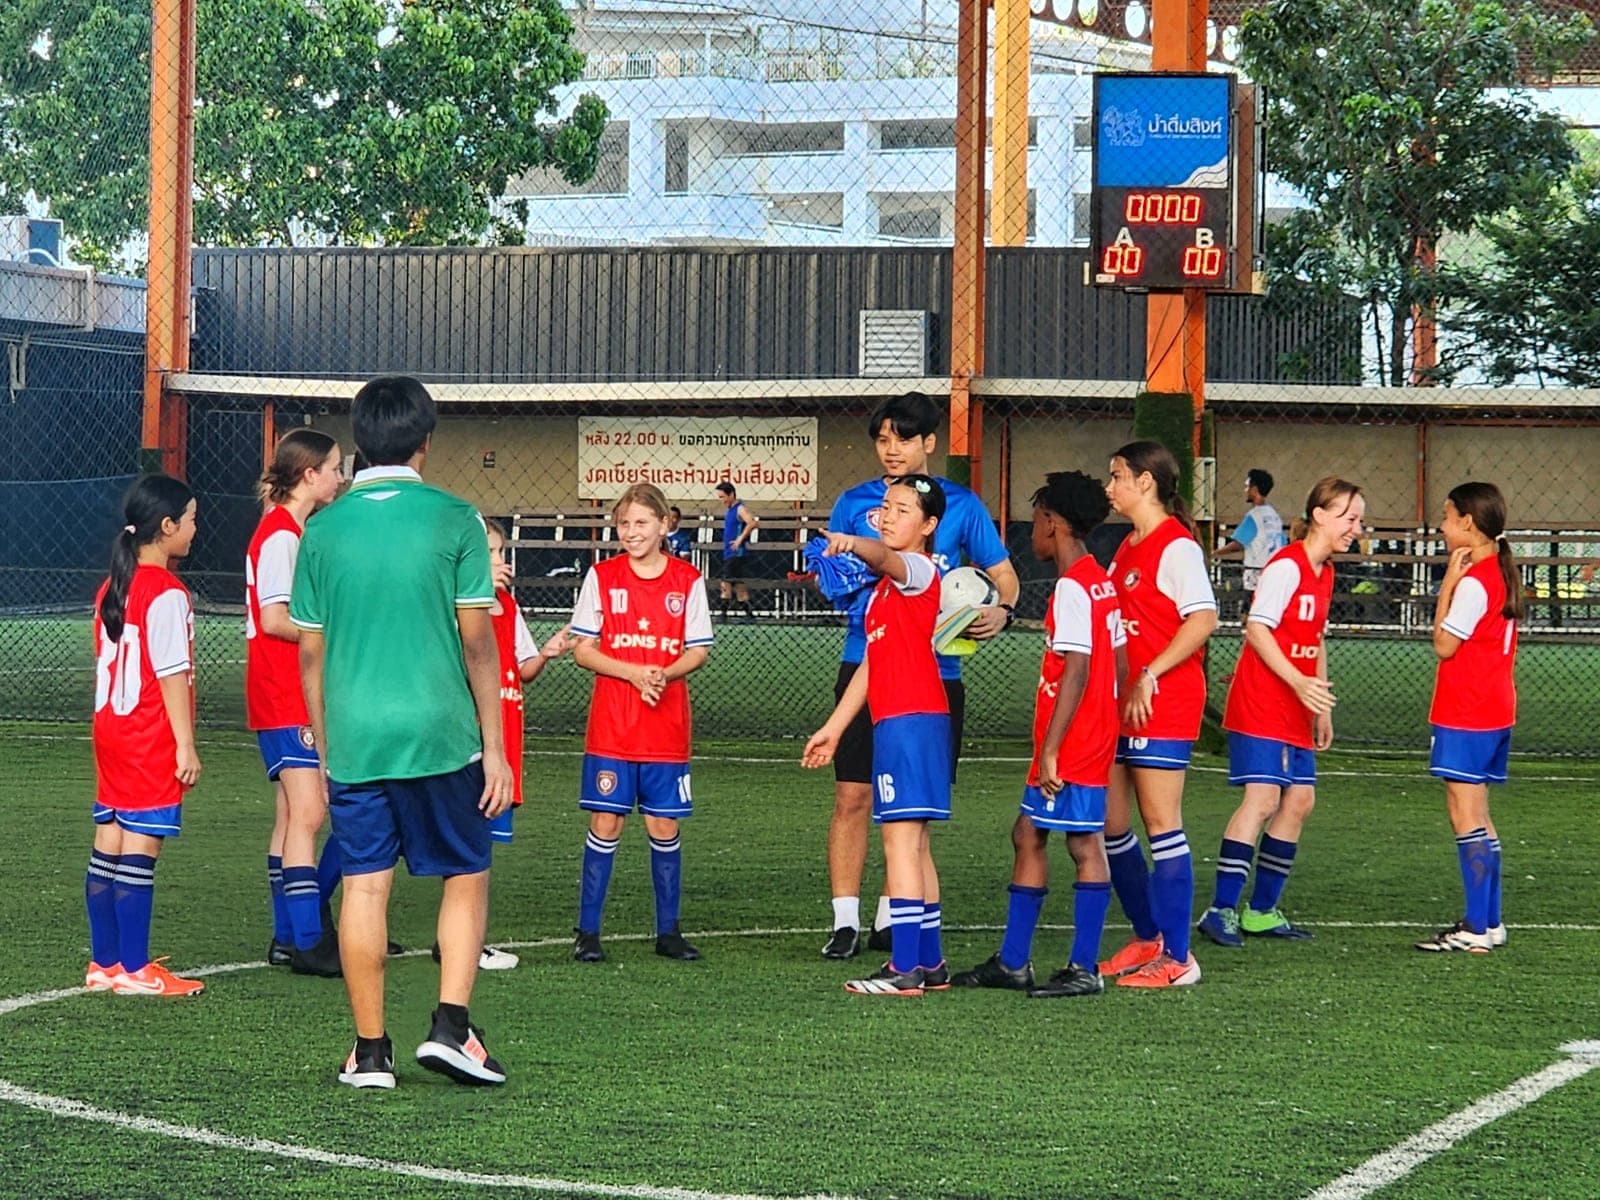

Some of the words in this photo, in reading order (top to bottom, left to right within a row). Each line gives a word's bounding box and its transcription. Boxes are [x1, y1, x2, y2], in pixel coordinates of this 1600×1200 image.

[1126, 194, 1201, 222] 0000
[1115, 227, 1135, 247] A
[1195, 228, 1215, 248] B
[1103, 247, 1141, 274] 00
[1183, 248, 1221, 275] 00
[585, 431, 610, 447] หลัง
[614, 432, 657, 446] 22.00
[609, 588, 628, 614] 10
[661, 636, 681, 656] FC
[877, 773, 896, 804] 16
